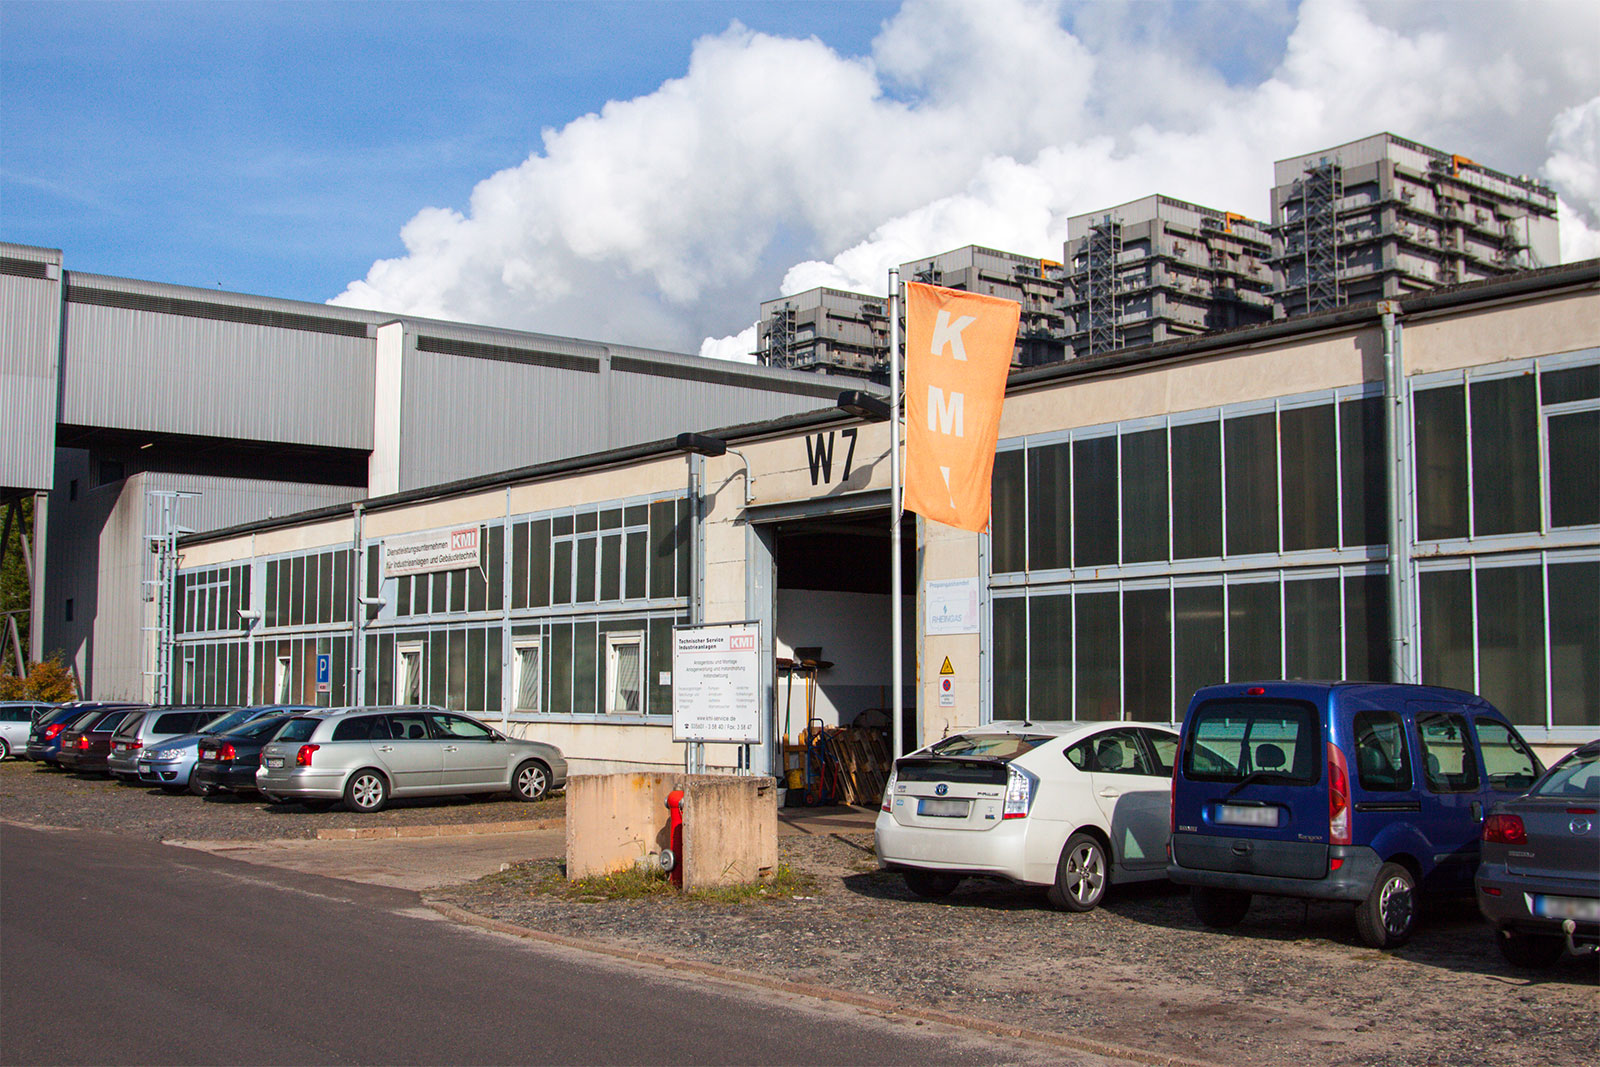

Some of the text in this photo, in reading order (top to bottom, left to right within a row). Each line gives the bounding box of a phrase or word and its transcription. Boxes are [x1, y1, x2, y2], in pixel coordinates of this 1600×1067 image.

[452, 532, 476, 549] KMI
[387, 542, 448, 556] Dienstleistungsunternehmen
[394, 556, 429, 568] Industrieanlagen
[430, 555, 438, 564] und
[439, 550, 477, 563] Gebäudetechnik
[932, 614, 962, 624] RHEINGAS
[731, 636, 754, 648] KMI
[320, 658, 327, 679] P
